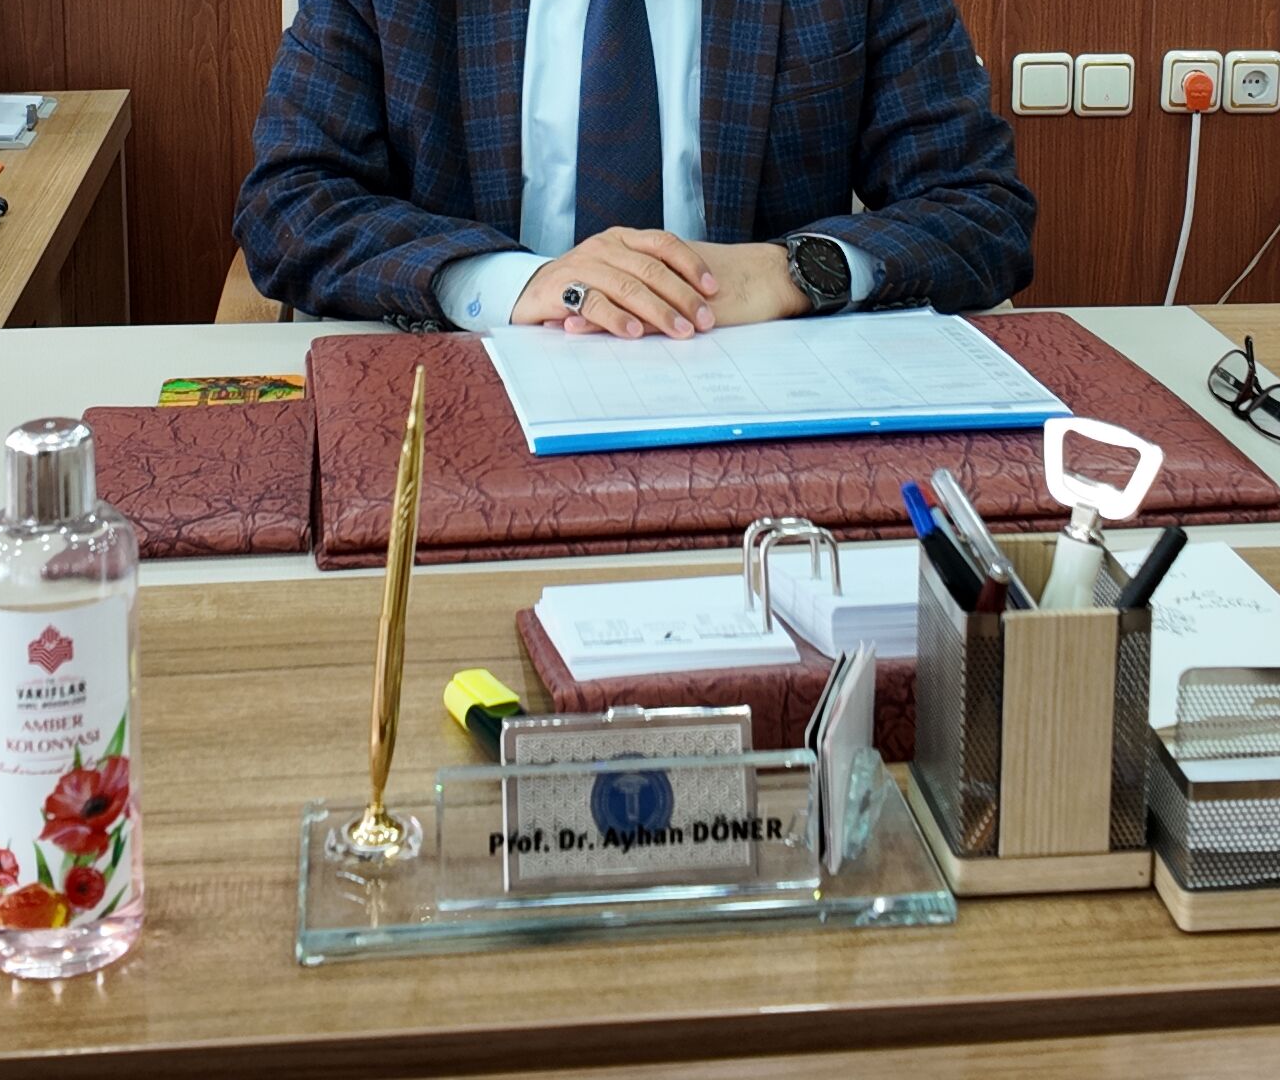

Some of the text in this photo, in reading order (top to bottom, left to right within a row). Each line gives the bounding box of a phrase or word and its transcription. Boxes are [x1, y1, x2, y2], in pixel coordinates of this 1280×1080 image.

[488, 816, 783, 854] Prof. Dr. Ayhan DÖNER
